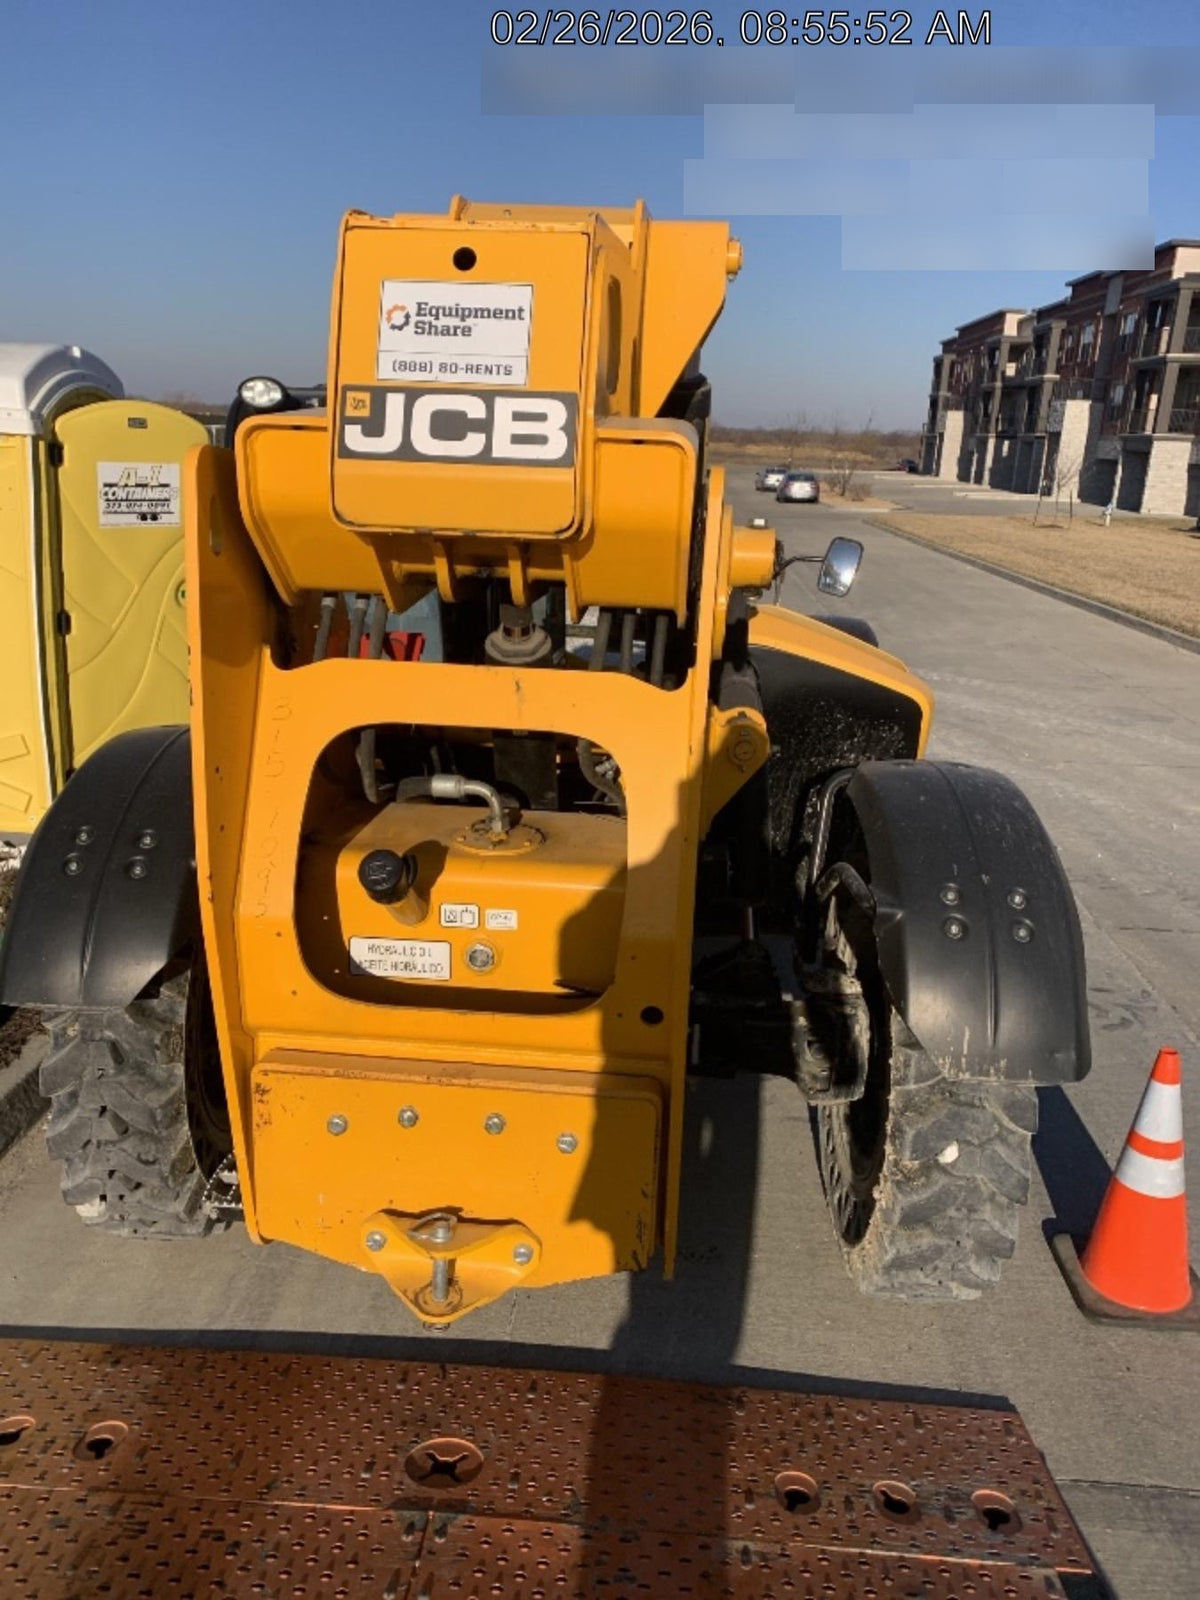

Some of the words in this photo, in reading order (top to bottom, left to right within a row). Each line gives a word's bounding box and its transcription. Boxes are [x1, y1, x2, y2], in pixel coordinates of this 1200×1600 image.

[414, 301, 526, 322] Equipment
[413, 320, 473, 337] Share
[438, 360, 513, 376] 80-RENTS
[344, 392, 568, 460] JCB
